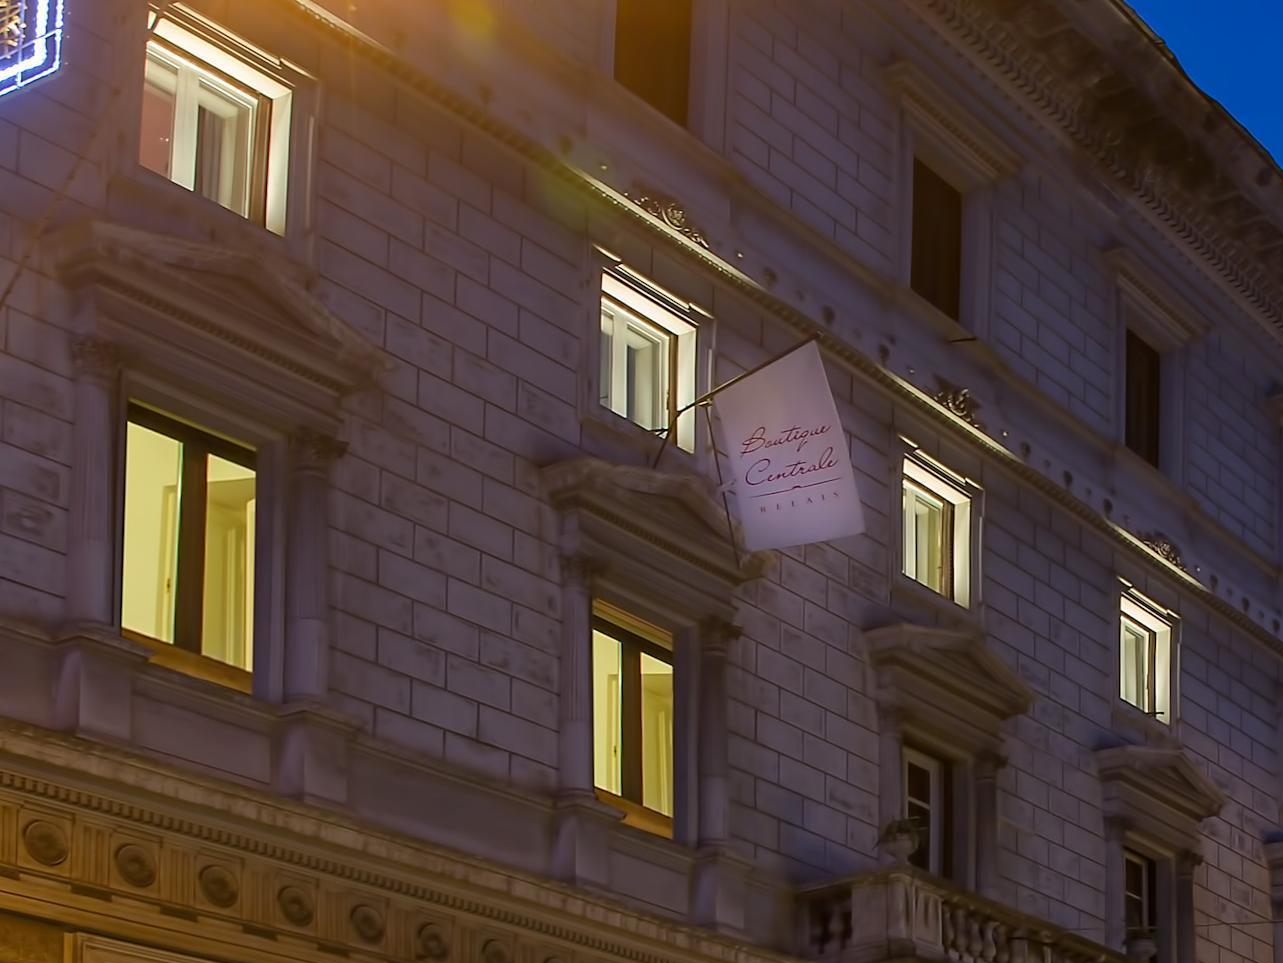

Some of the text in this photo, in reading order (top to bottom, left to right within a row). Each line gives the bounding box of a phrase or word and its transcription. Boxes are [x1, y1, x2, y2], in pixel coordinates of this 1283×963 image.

[740, 425, 831, 455] Boutique
[745, 446, 838, 486] Centrale
[759, 491, 841, 513] RELAIS
